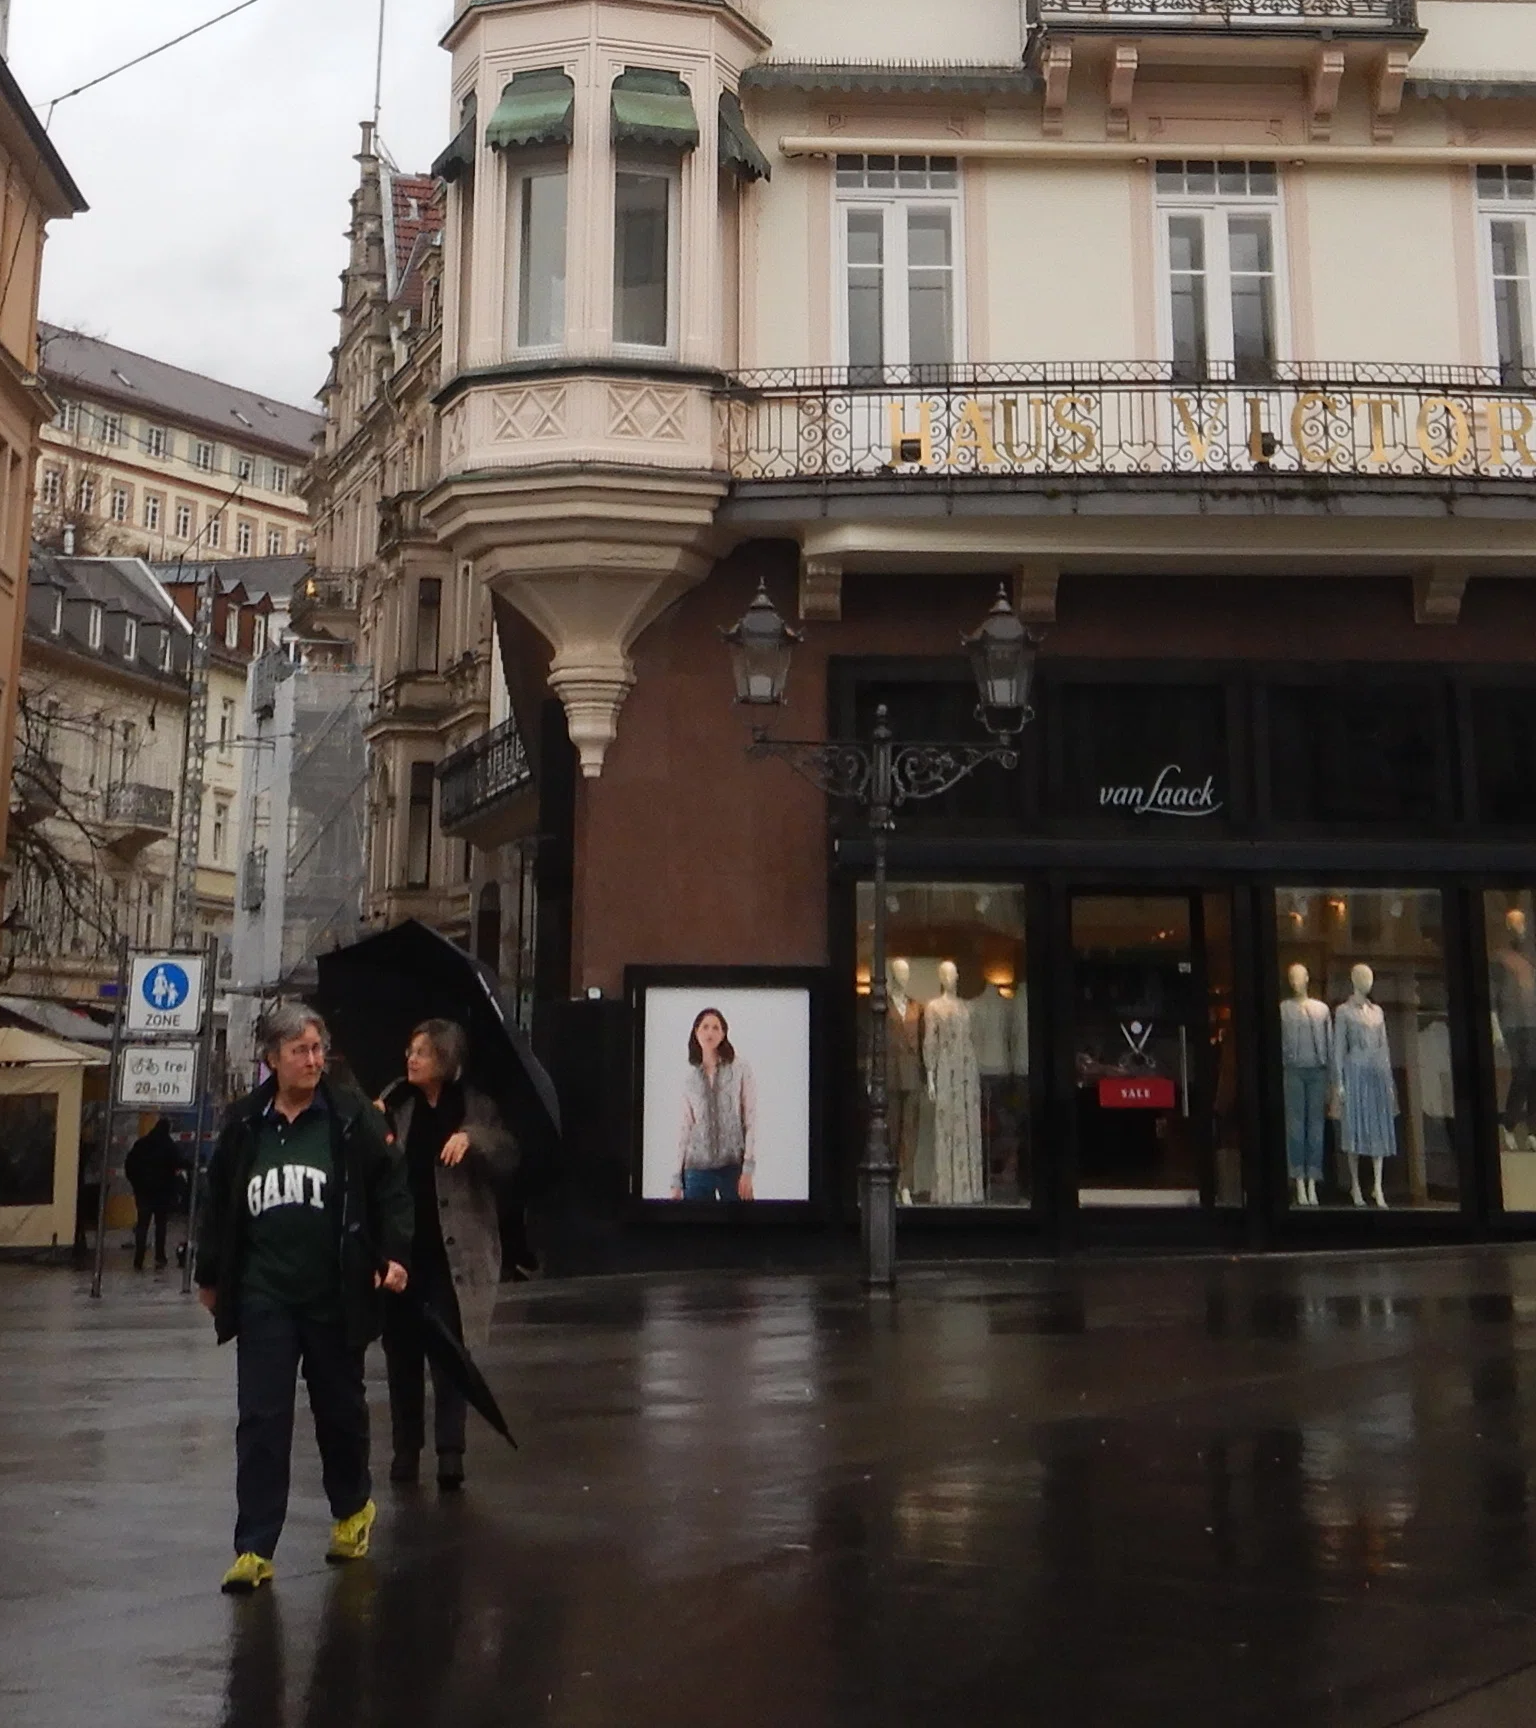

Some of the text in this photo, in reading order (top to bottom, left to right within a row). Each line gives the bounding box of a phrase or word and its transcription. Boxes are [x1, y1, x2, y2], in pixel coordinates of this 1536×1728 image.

[888, 395, 1098, 466] HAUS
[145, 1014, 181, 1026] ZONE
[165, 1061, 187, 1073] frei
[1120, 1088, 1151, 1100] SALE
[247, 1164, 327, 1217] GANT
